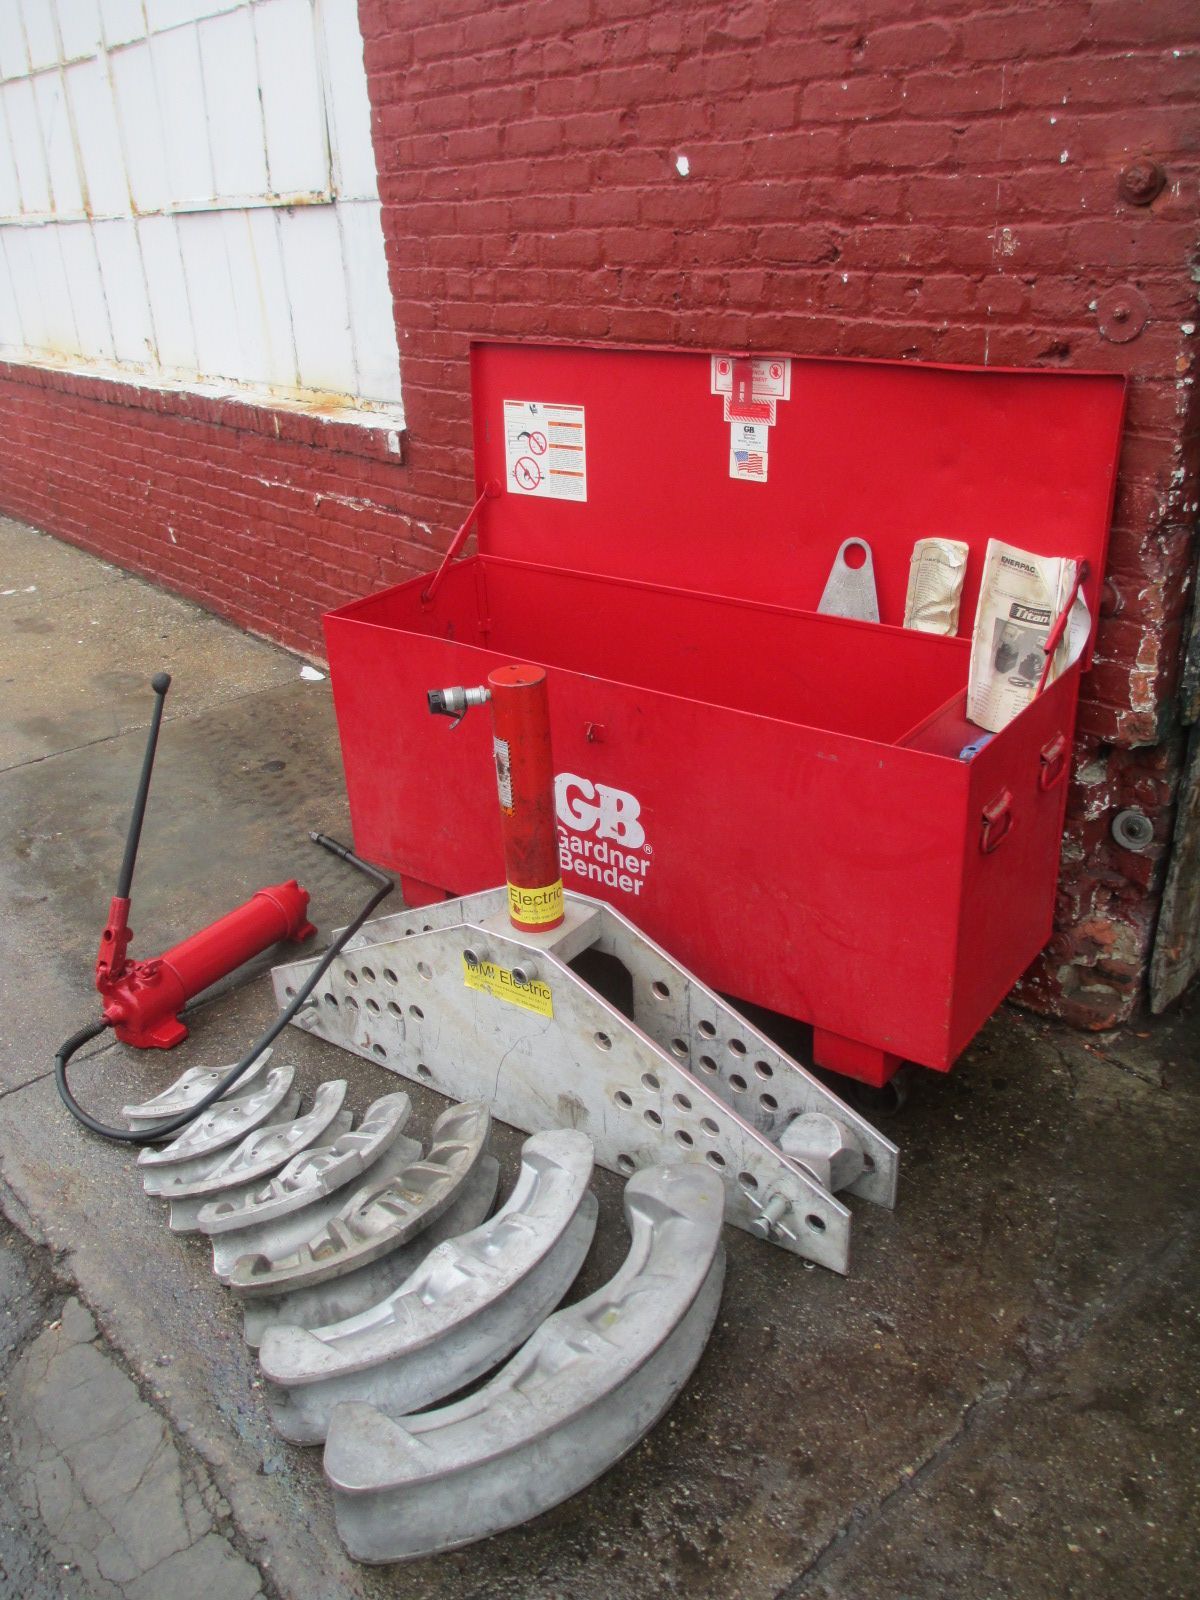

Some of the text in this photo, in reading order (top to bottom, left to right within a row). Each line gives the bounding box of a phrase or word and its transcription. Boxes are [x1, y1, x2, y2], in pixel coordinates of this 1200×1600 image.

[1000, 555, 1036, 574] ENERPAC
[1015, 606, 1049, 624] Titan
[554, 772, 646, 849] GB
[560, 848, 644, 896] Bender
[510, 886, 562, 906] Electric
